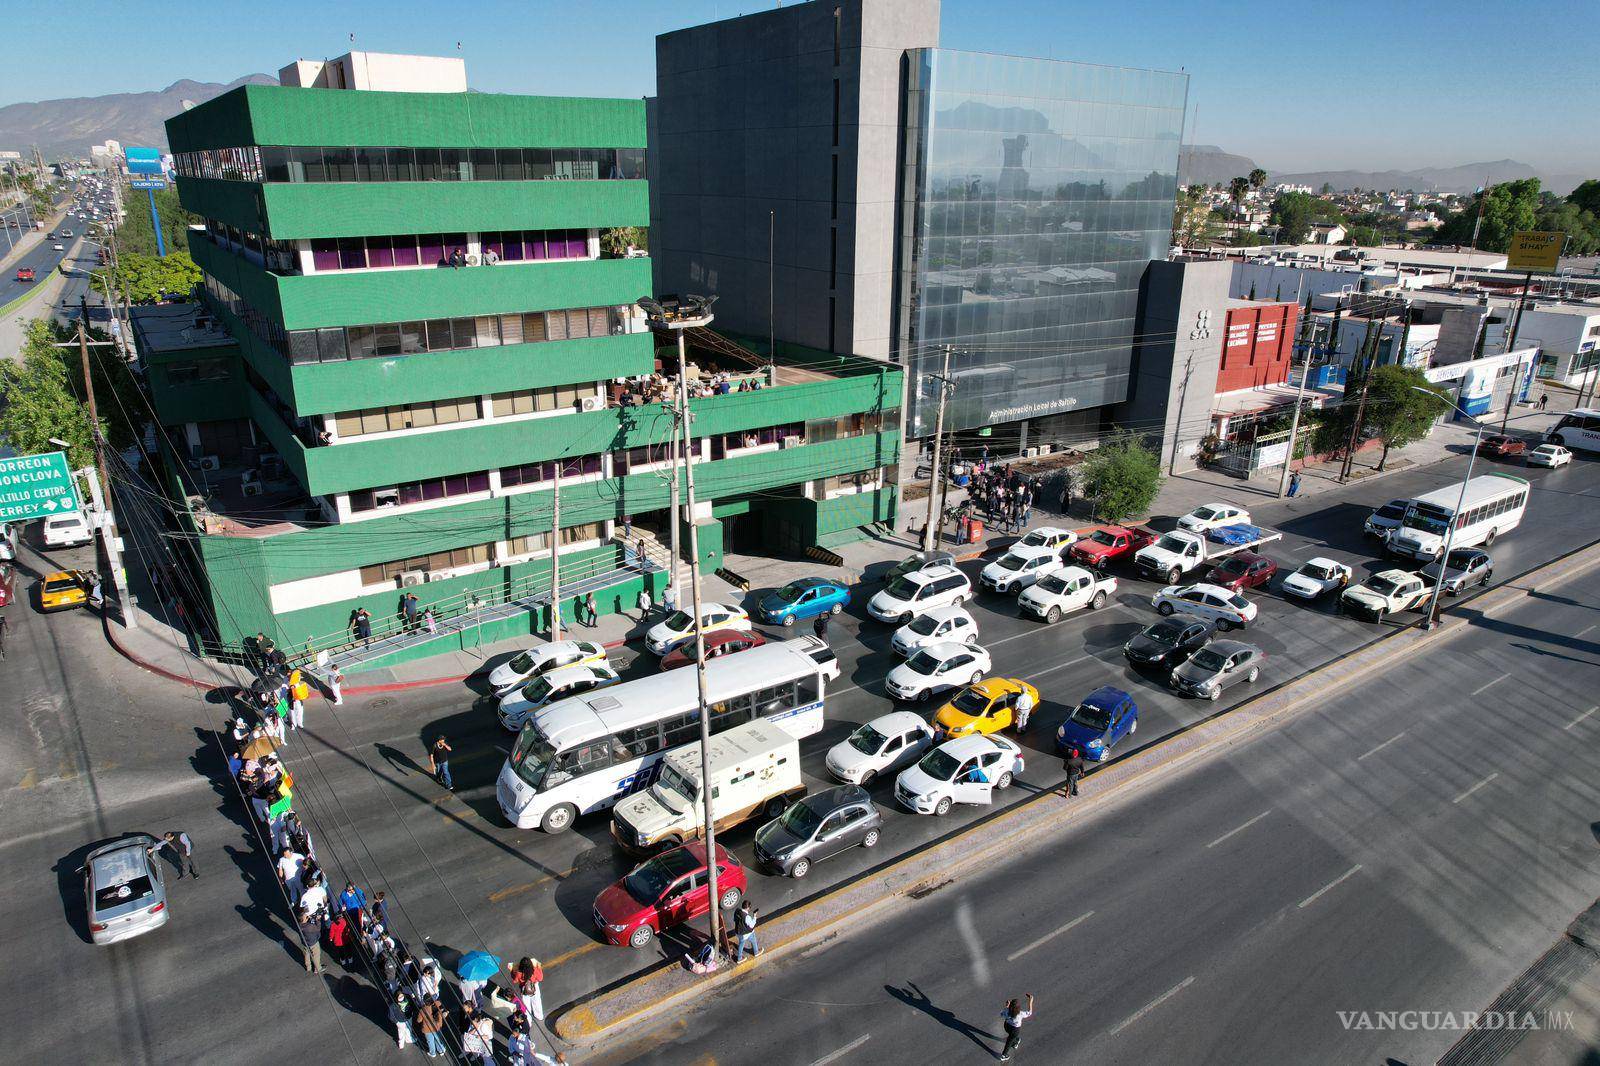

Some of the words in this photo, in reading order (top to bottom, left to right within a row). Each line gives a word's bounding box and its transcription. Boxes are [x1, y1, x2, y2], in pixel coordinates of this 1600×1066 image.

[1190, 329, 1211, 340] SAT
[989, 404, 1032, 418] Administración
[1033, 402, 1049, 411] Local
[1050, 400, 1057, 408] de
[1058, 397, 1077, 407] Saltillo
[34, 486, 66, 499] CENTRO
